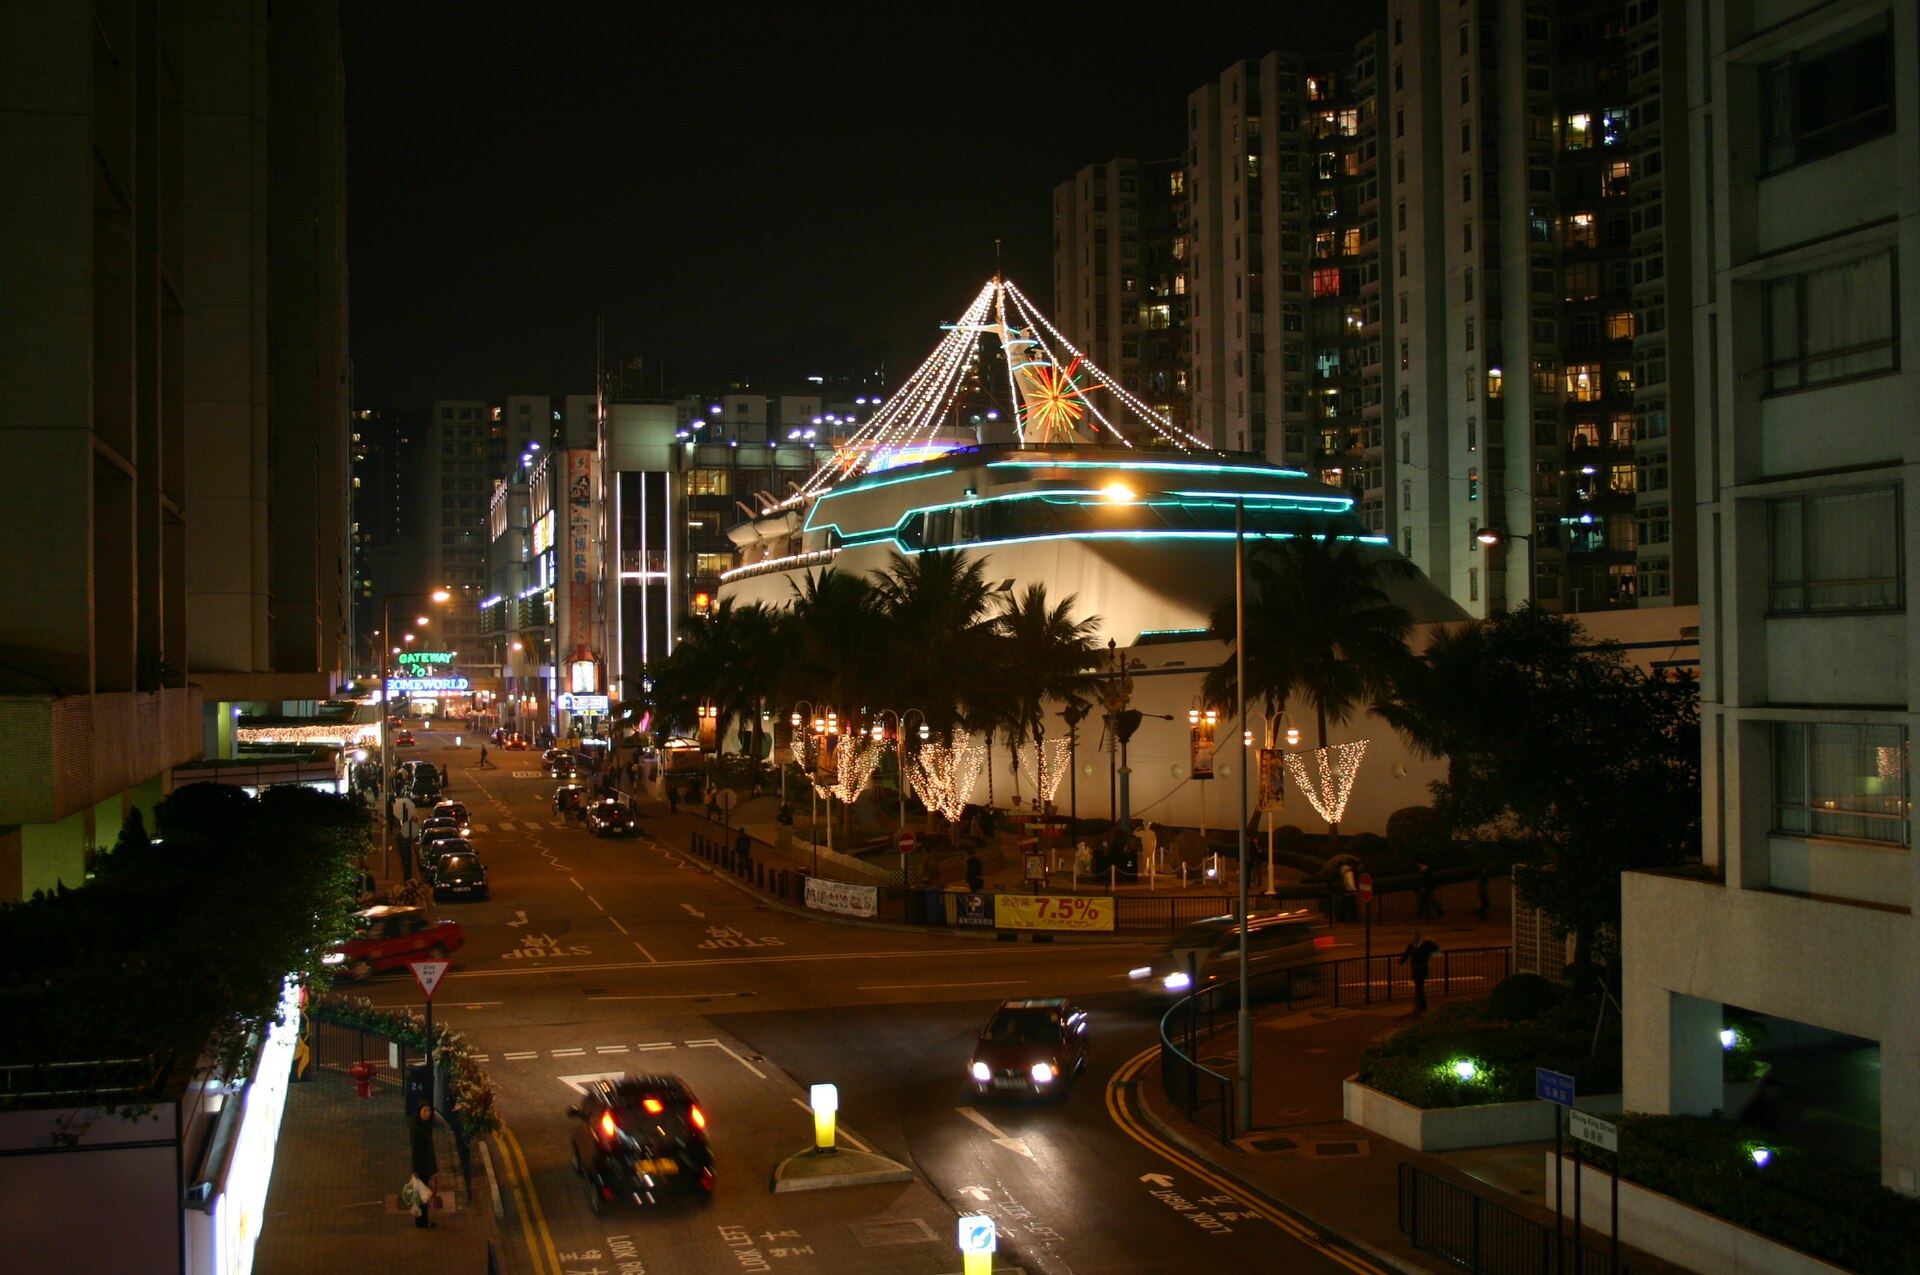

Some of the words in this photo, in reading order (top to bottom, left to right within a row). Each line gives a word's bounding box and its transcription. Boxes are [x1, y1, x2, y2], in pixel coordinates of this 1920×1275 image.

[399, 653, 452, 664] GATEWAY
[412, 664, 426, 677] TO
[1035, 898, 1099, 920] 7.5%
[501, 945, 592, 959] STOP
[697, 936, 787, 949] STOP
[1149, 1190, 1199, 1210] RIGHT
[1184, 1212, 1233, 1234] LOOK
[717, 1225, 754, 1247] LEFT
[606, 1235, 638, 1259] LOOK
[734, 1249, 772, 1272] LOOK
